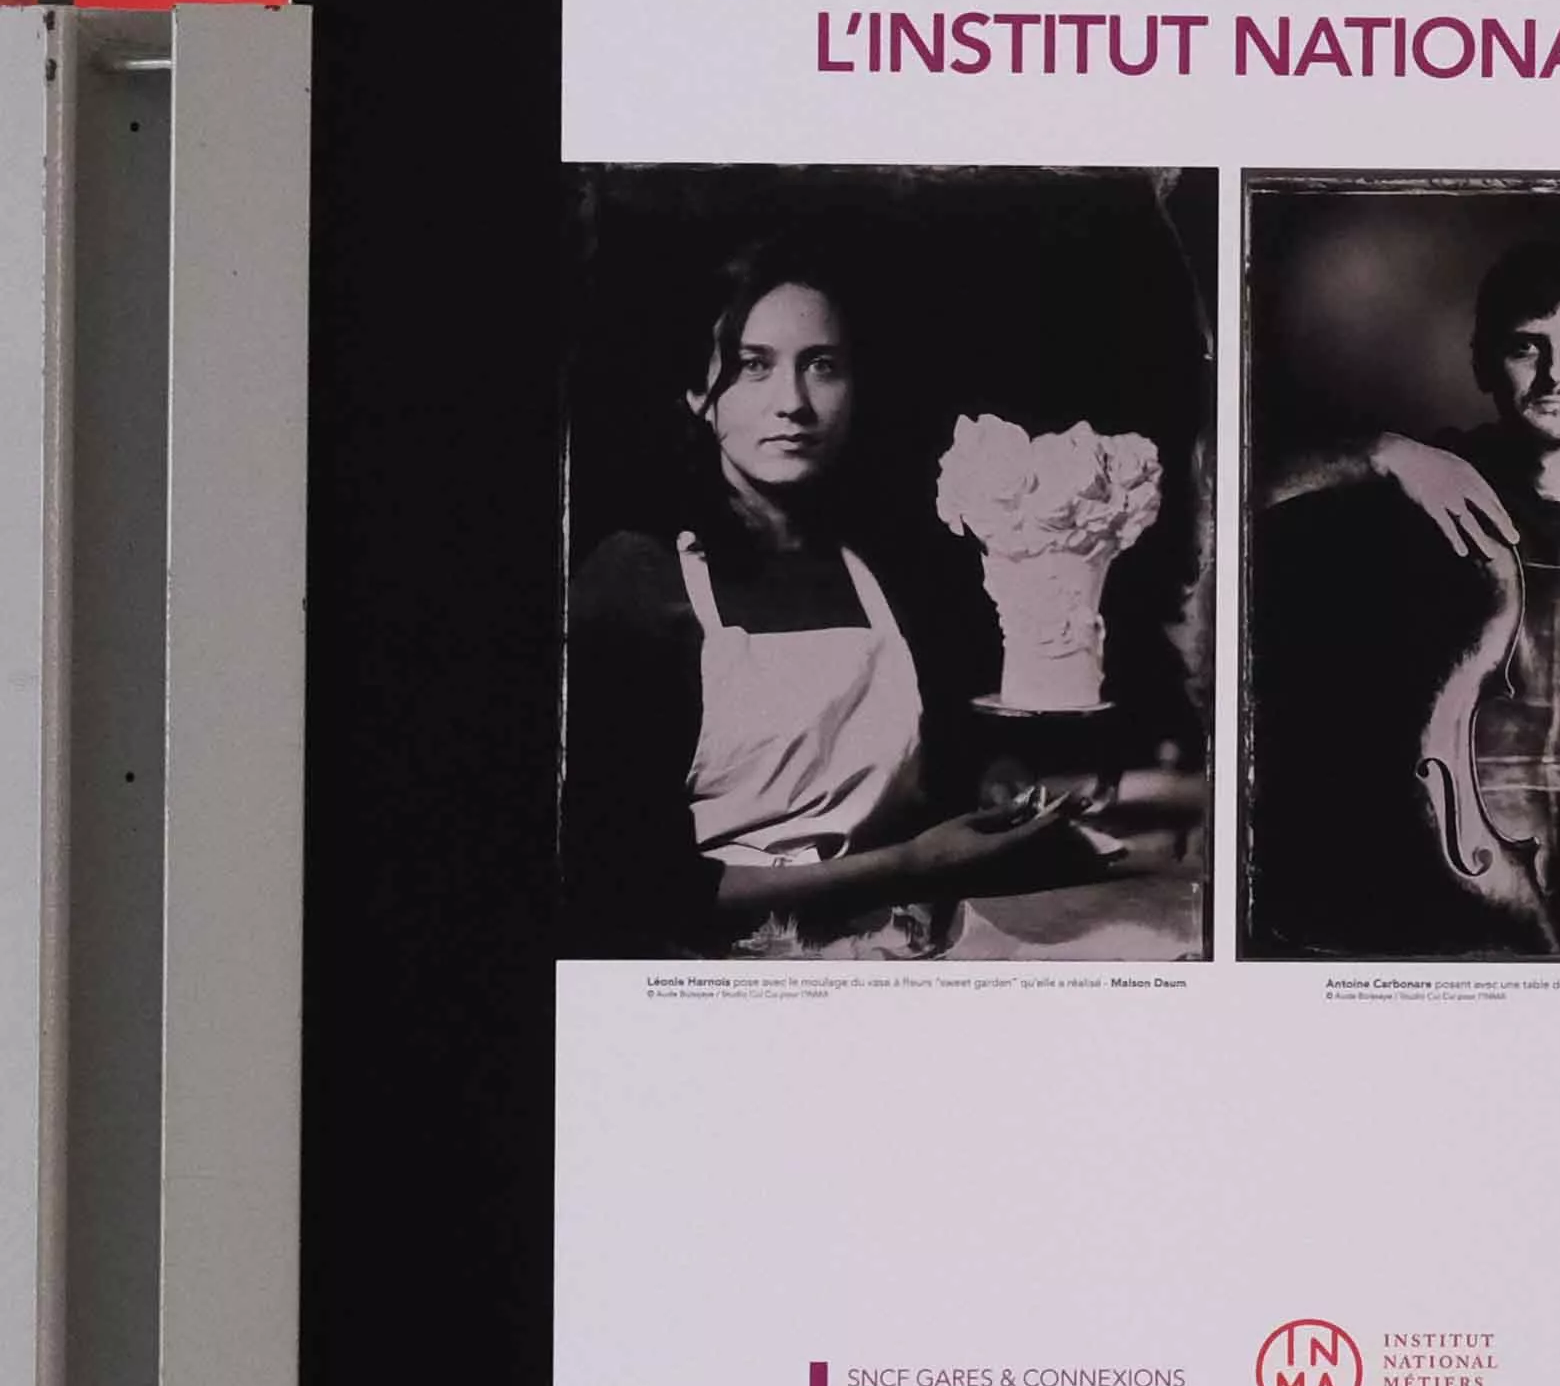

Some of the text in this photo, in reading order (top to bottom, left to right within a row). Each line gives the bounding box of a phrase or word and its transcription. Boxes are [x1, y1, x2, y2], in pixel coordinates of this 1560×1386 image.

[817, 12, 1209, 76] L'INSTITUT
[1384, 1333, 1494, 1348] INSTITUT
[1384, 1355, 1498, 1369] NATIONAL
